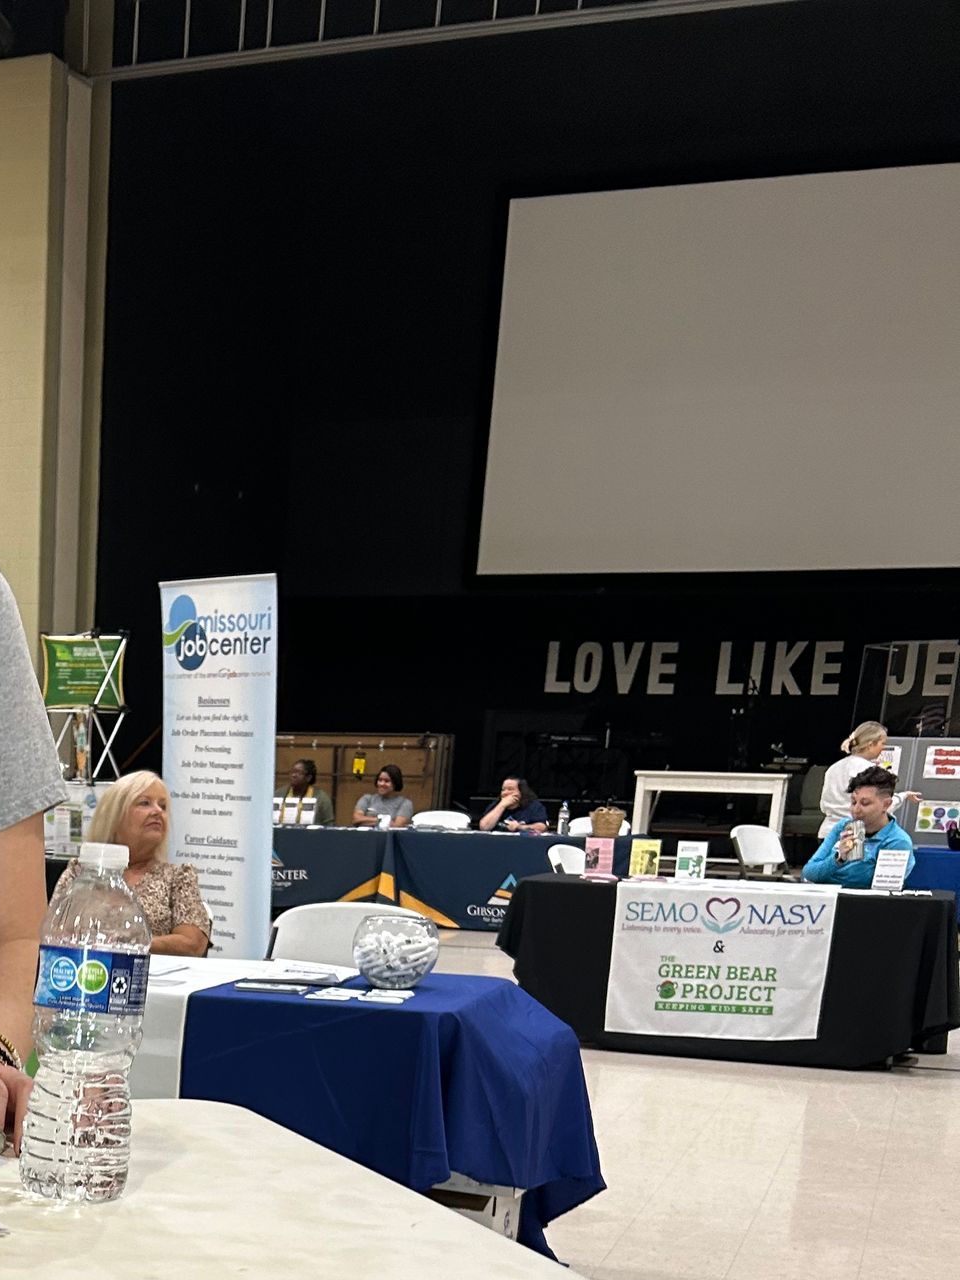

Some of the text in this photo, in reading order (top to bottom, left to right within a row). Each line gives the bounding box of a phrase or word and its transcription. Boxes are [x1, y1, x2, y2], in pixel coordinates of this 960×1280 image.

[197, 606, 272, 633] missouri
[544, 641, 679, 695] LOVE
[715, 641, 844, 695] LIKE
[184, 834, 238, 846] Career Guidance
[272, 869, 308, 881] ENTER
[625, 901, 826, 925] SEMO NASV
[621, 923, 653, 934] Listening
[739, 926, 775, 937] Advocating
[713, 940, 725, 953] &
[658, 963, 777, 981] GREEN BEAR
[681, 983, 776, 1001] PROJECT
[657, 1002, 769, 1014] KEEPING KIDS SAFE
